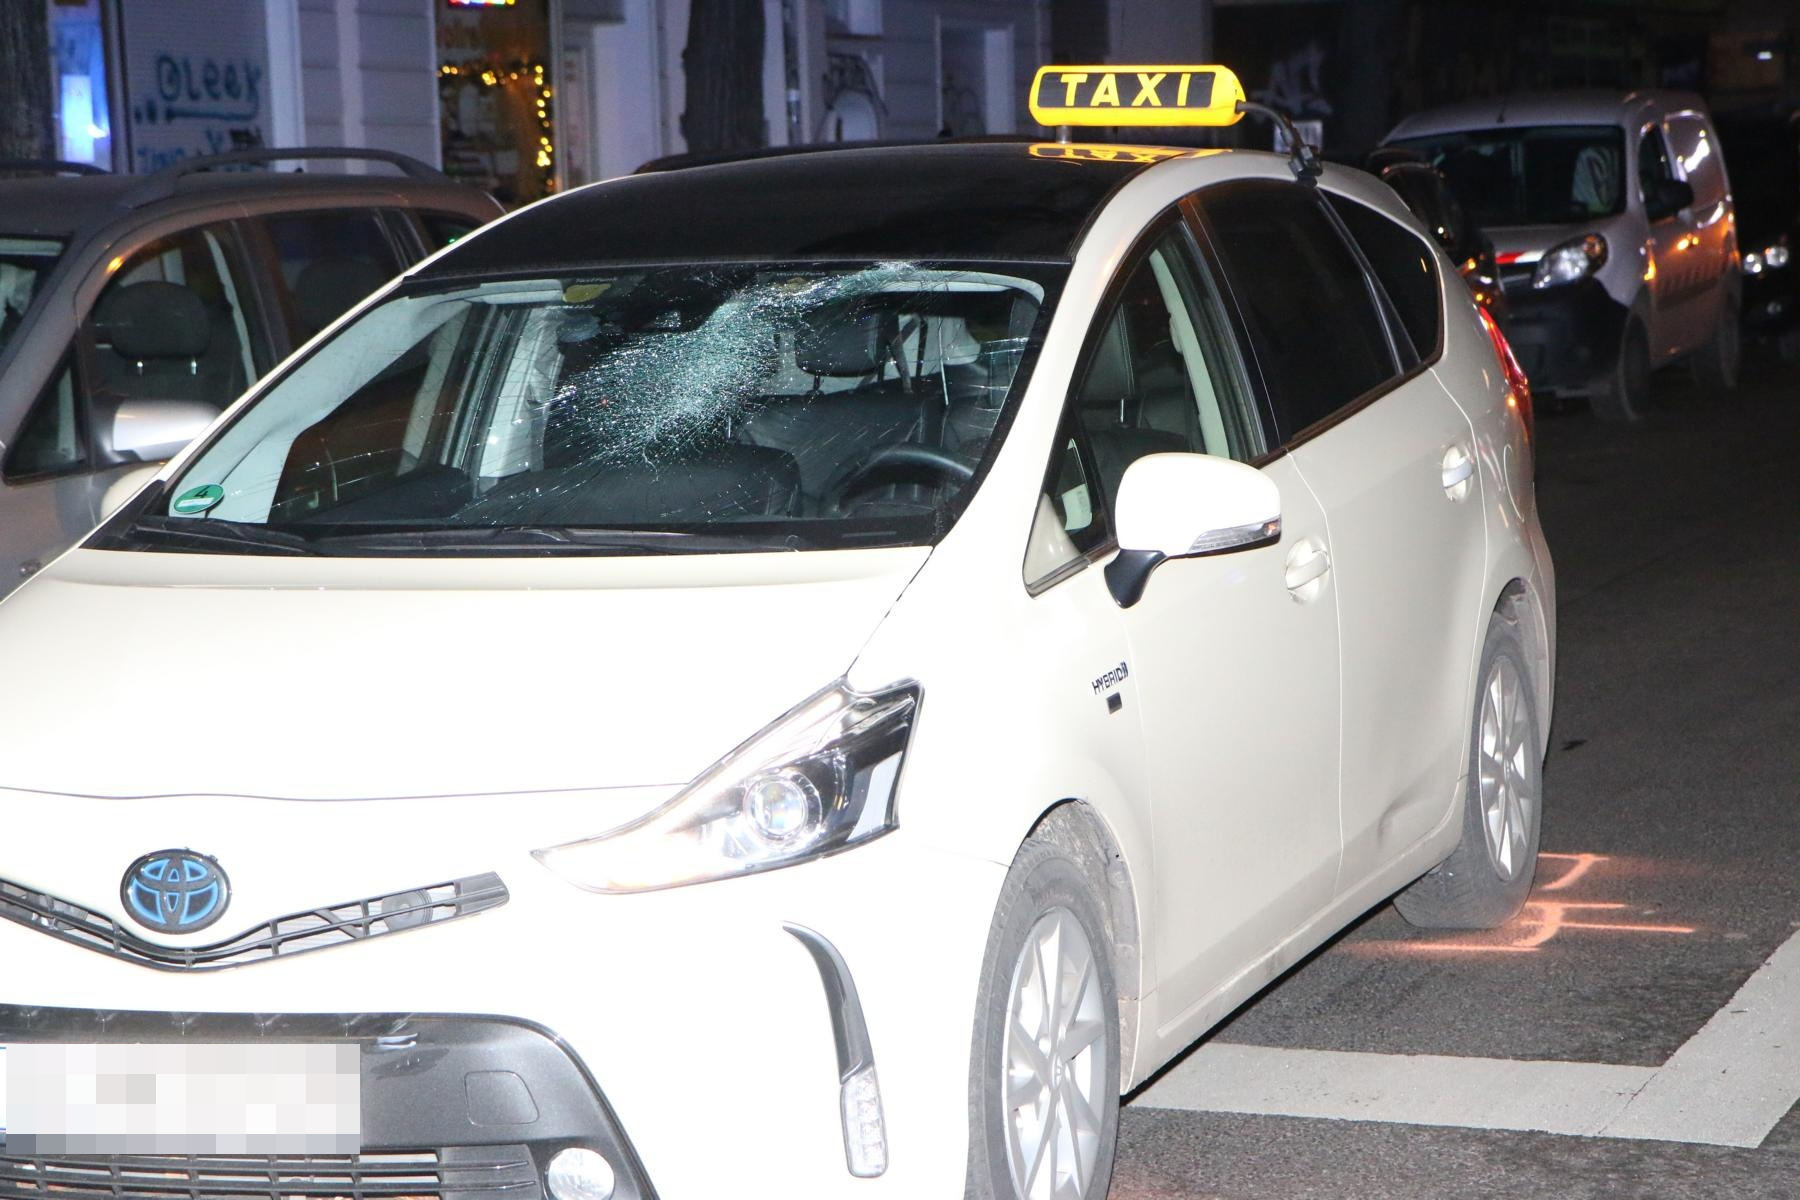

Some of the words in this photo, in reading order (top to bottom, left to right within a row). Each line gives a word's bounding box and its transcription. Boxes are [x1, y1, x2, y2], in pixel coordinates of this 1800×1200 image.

[1060, 73, 1191, 107] TAXI
[194, 485, 210, 498] 4
[1091, 666, 1124, 694] HYBRID
